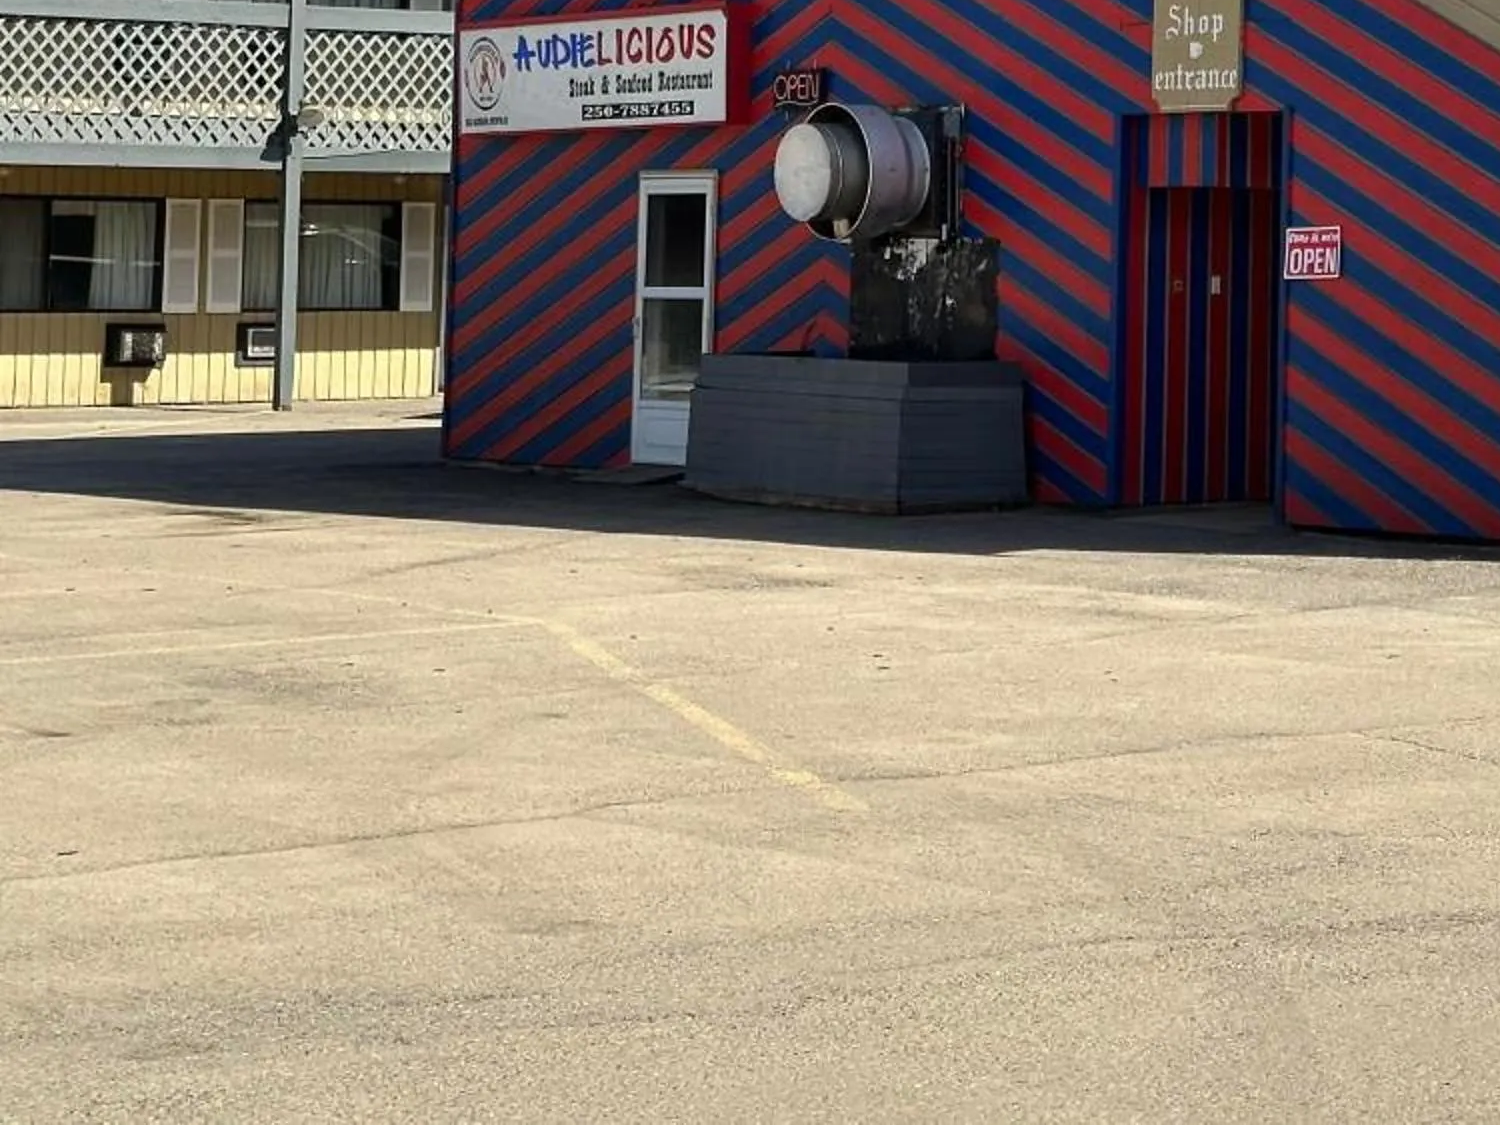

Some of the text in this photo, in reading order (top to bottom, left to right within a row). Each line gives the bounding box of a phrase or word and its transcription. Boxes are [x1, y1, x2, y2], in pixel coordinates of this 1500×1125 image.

[1165, 4, 1224, 42] Shop
[512, 23, 717, 72] AUDIELICIOUS
[569, 68, 714, 98] Steak & Seafood Restaurant
[773, 72, 821, 101] OPEN
[1154, 64, 1239, 92] entrance
[583, 102, 692, 119] 250-7887455
[1289, 247, 1337, 274] OPEN
